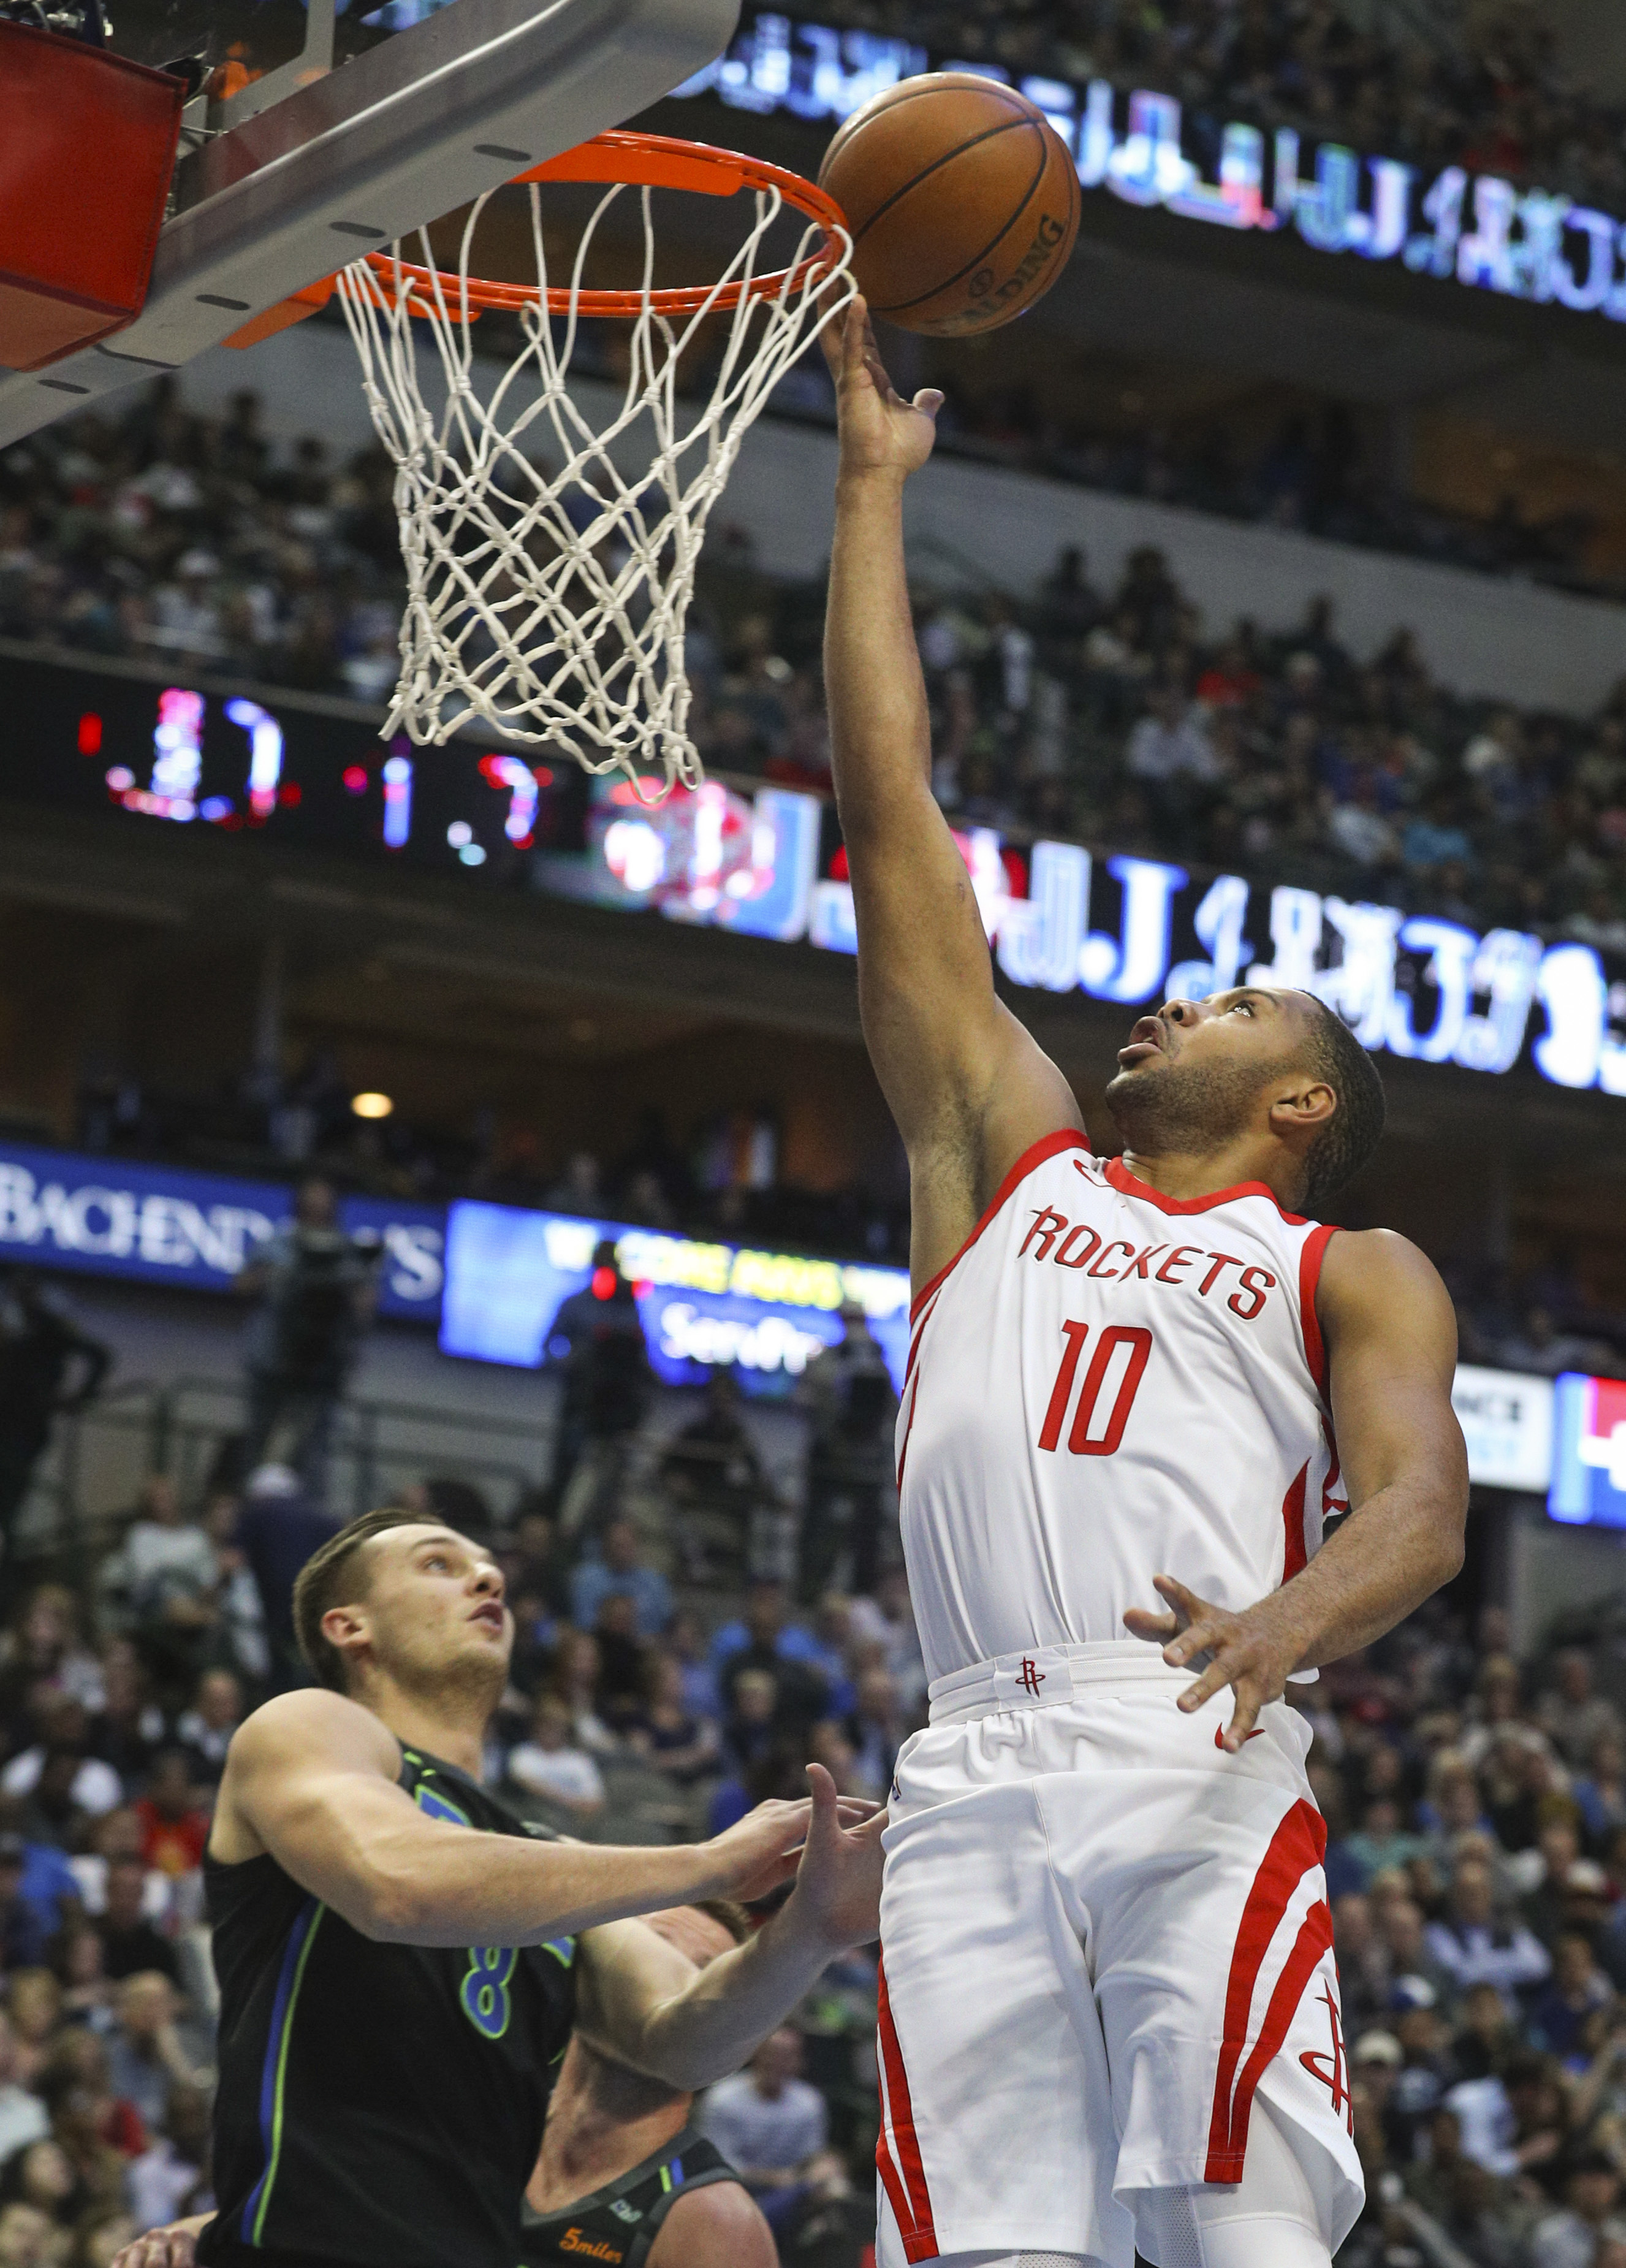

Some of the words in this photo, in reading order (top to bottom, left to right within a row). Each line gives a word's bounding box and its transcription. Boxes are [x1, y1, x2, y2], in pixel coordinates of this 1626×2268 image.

[1017, 1204, 1277, 1320] ROCKETS
[1038, 1319, 1153, 1456] 10
[558, 2226, 624, 2265] 5miles
